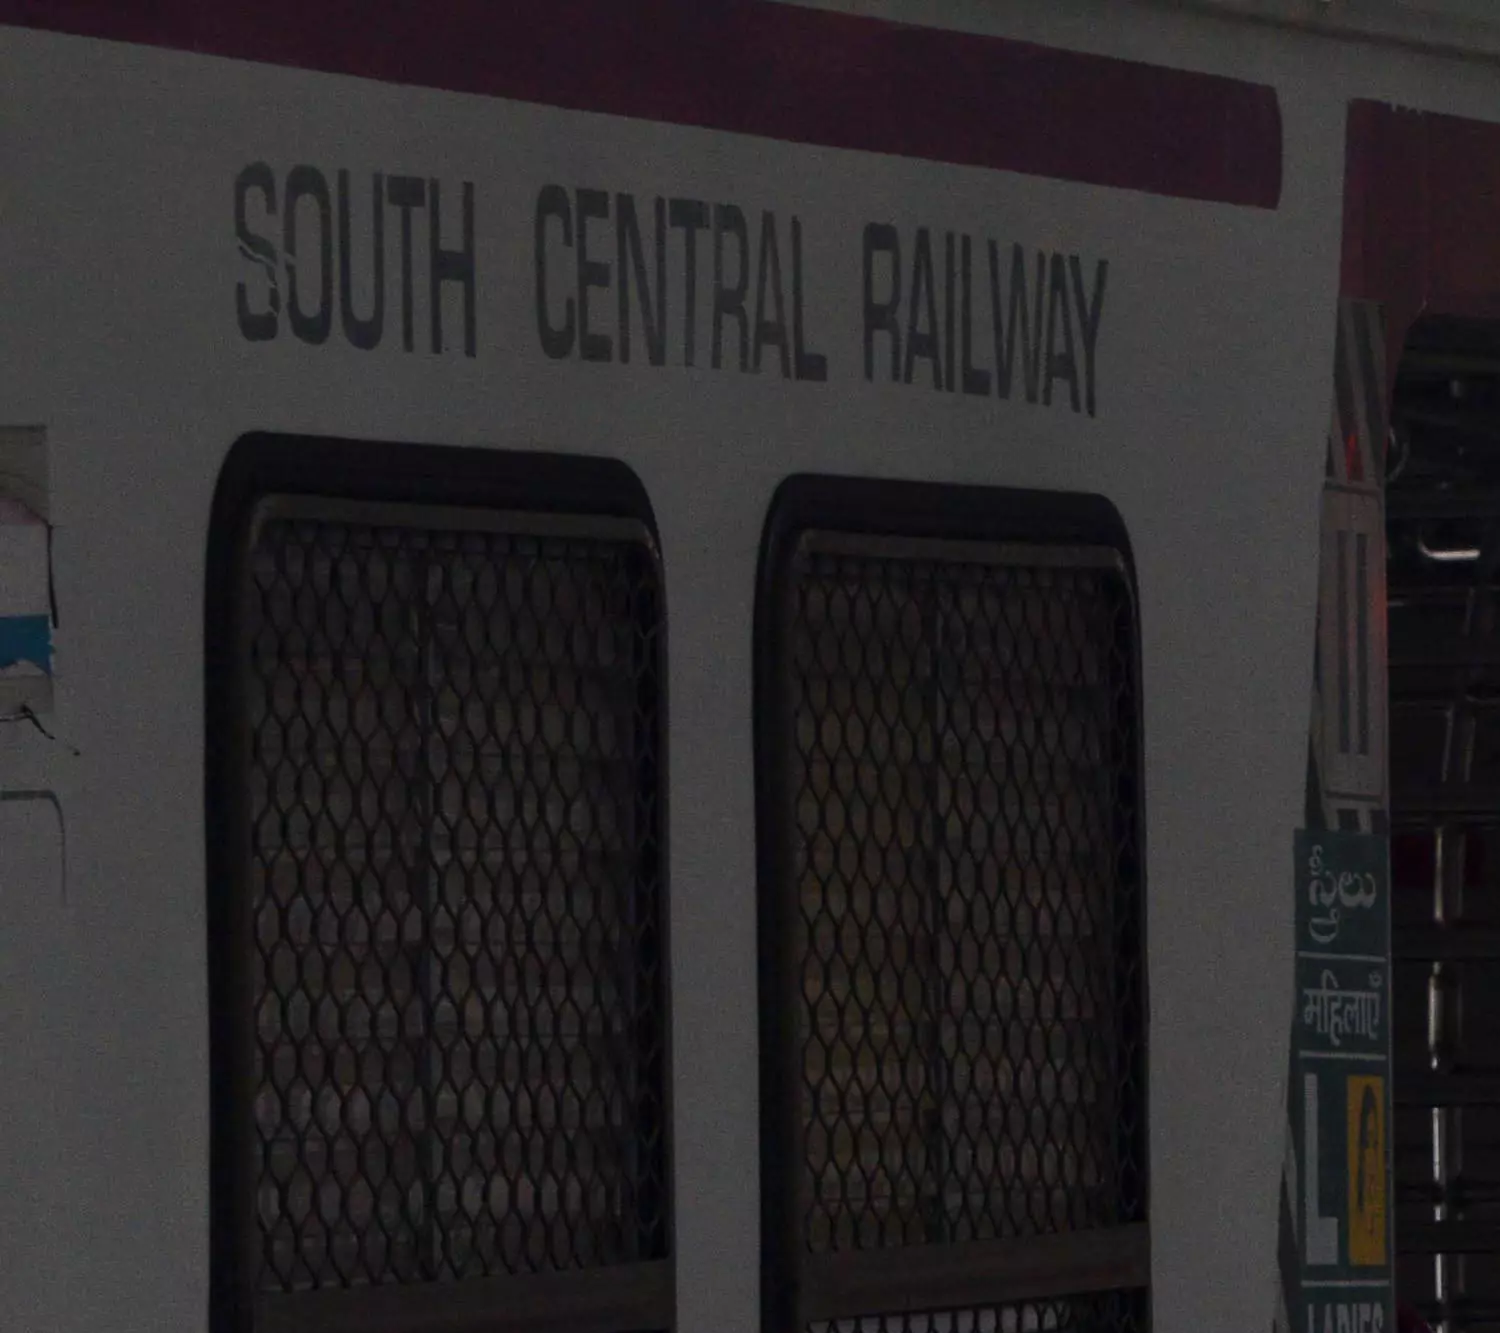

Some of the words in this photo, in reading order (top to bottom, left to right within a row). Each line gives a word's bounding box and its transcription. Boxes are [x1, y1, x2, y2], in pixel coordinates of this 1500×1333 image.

[235, 162, 477, 358] SOUTH
[534, 183, 828, 383] CENTRAL
[863, 222, 1109, 419] RAILWAY
[1304, 1074, 1339, 1266] L
